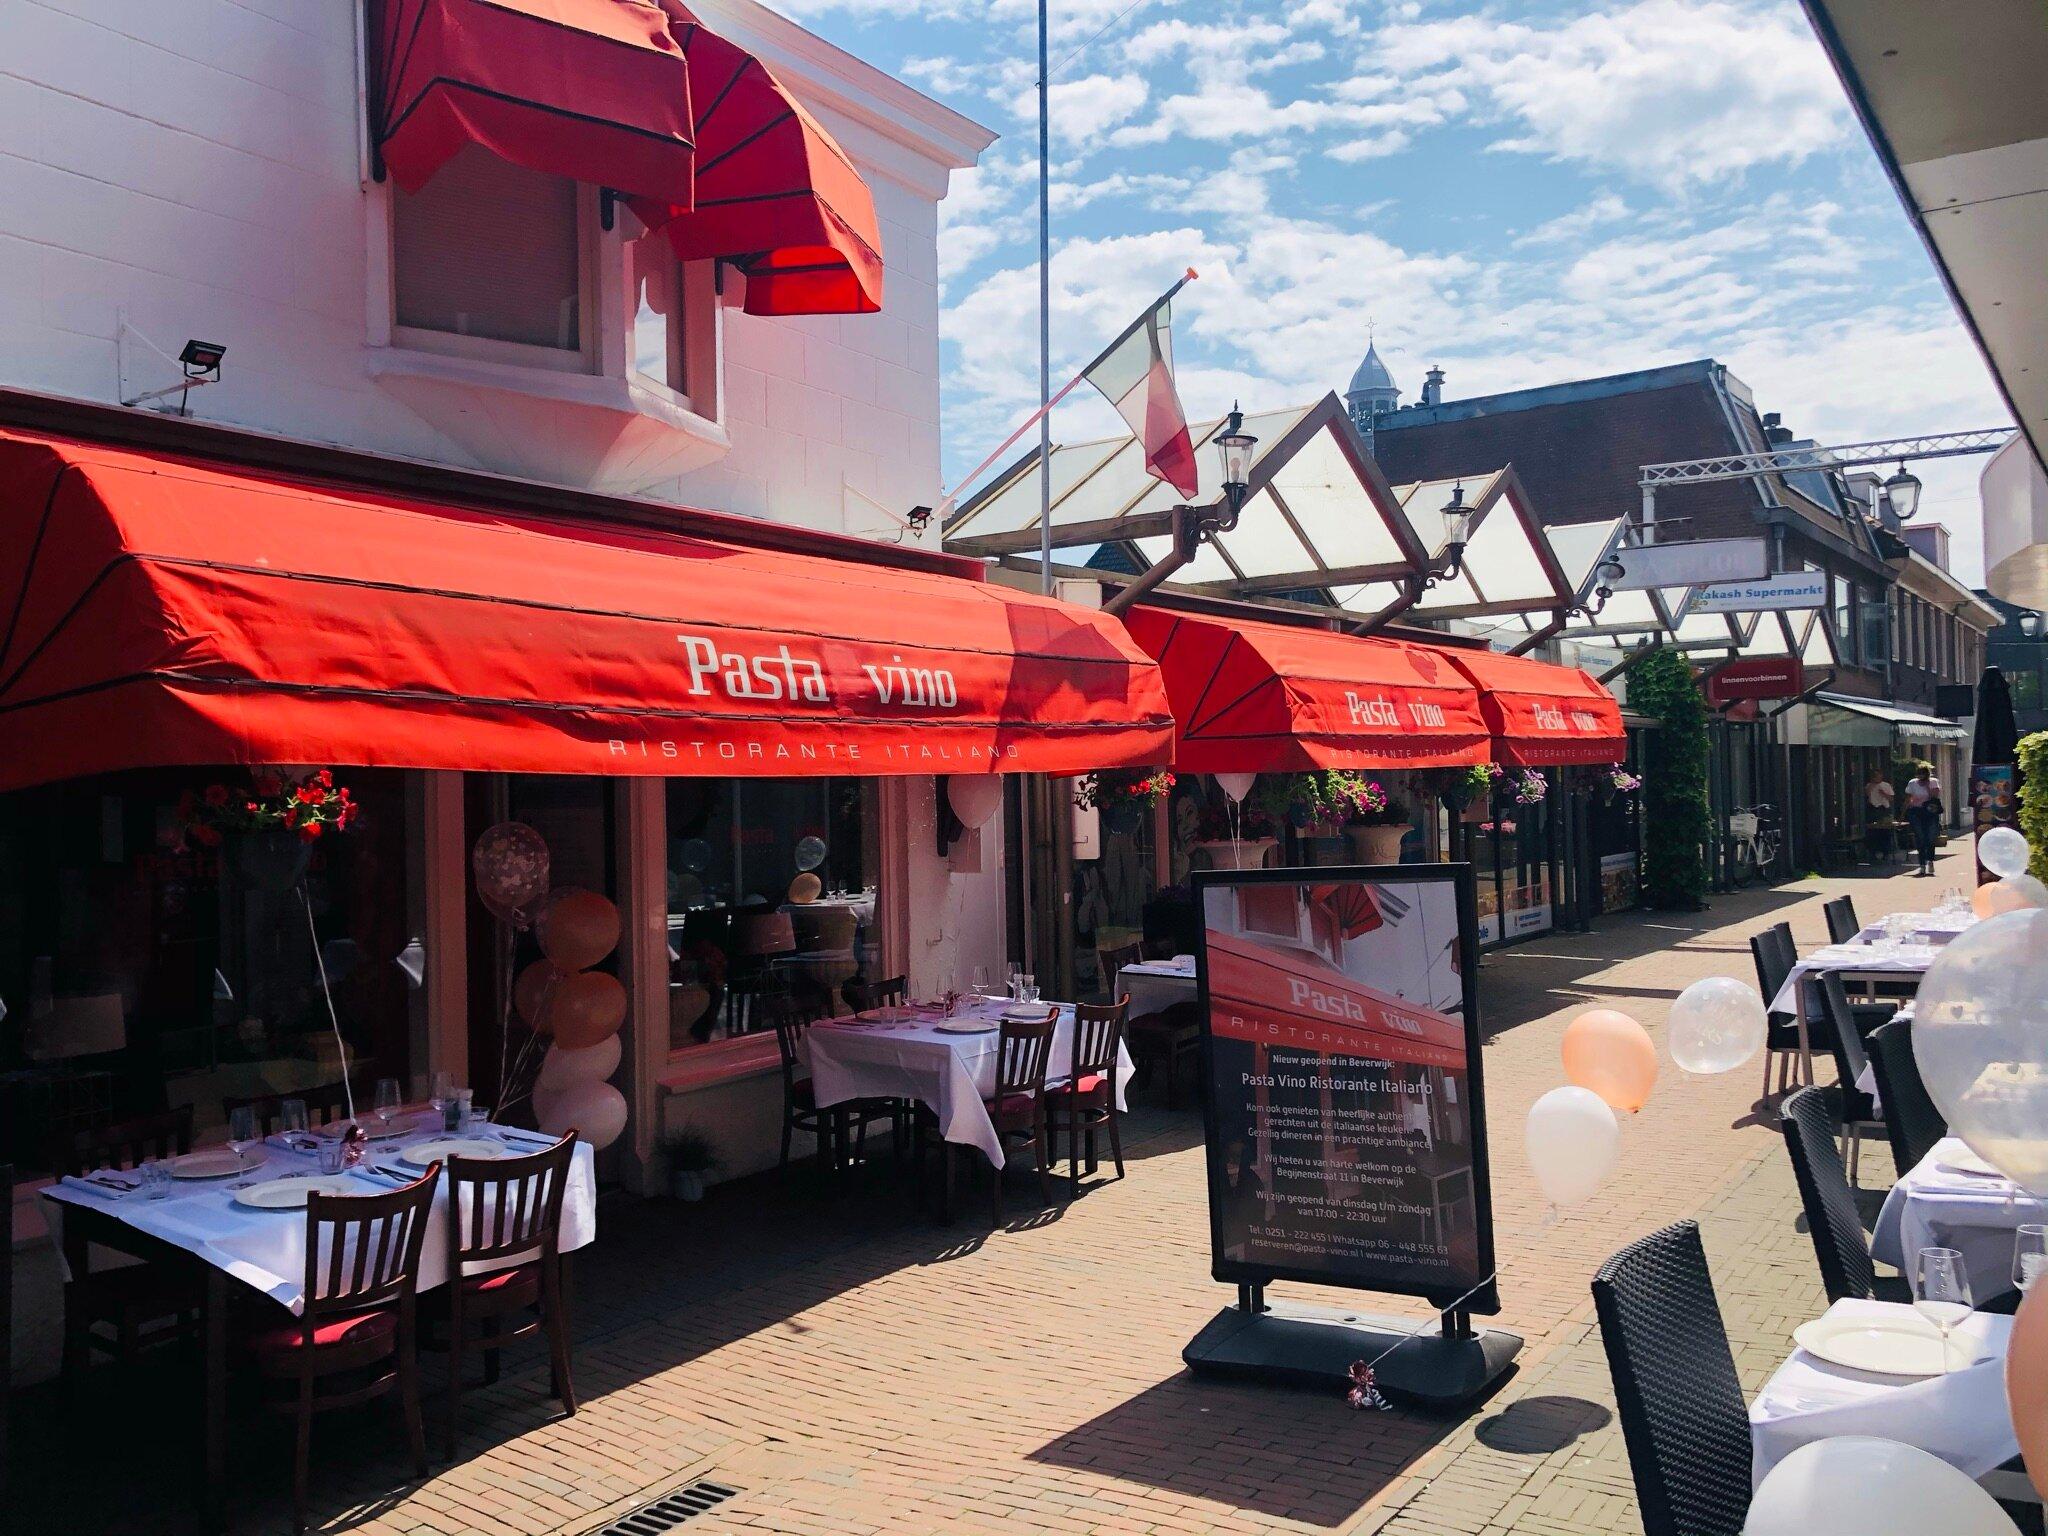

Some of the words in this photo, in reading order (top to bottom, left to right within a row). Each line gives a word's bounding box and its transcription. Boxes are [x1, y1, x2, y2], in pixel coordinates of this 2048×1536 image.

[1746, 585, 1824, 599] Supermarkt
[677, 635, 830, 702] Pasta
[861, 655, 958, 708] vino
[1344, 691, 1400, 727] Pasta
[1407, 696, 1446, 727] vino
[1532, 703, 1569, 731] Pasta
[608, 739, 861, 760] RISTORANTE
[886, 744, 1019, 759] ITALIANO
[1330, 749, 1412, 760] RISTORANTE
[1419, 748, 1475, 759] ITALIANO
[1287, 977, 1368, 1023] Pasta
[1380, 1011, 1423, 1035] vino
[1231, 1016, 1381, 1051] RISTORANTE
[1391, 1046, 1448, 1061] ITALIANO
[1272, 1054, 1299, 1064] Nieuw
[1300, 1056, 1337, 1067] geopend
[1339, 1057, 1347, 1066] in
[1349, 1057, 1395, 1070] Beverwijk:
[1242, 1072, 1275, 1087] Pasta
[1278, 1074, 1306, 1088] Vino
[1309, 1076, 1377, 1092] Ristorante
[1381, 1079, 1433, 1095] Italiano
[1246, 1102, 1264, 1112] Kom
[1265, 1104, 1281, 1113] ook
[1282, 1106, 1319, 1116] genieten
[1320, 1109, 1337, 1117] van
[1338, 1108, 1376, 1121] heerlijke
[1264, 1118, 1306, 1128] gerechten
[1307, 1119, 1319, 1129] uit
[1320, 1120, 1332, 1129] de
[1333, 1121, 1375, 1132] italiaanse
[1248, 1127, 1280, 1140] Gezellig
[1281, 1130, 1313, 1141] dineren
[1314, 1132, 1323, 1141] in
[1324, 1134, 1340, 1143] een
[1342, 1136, 1385, 1148] prachtige
[1264, 1153, 1277, 1165] Wij
[1279, 1155, 1303, 1166] heten
[1312, 1159, 1328, 1168] van
[1330, 1160, 1353, 1169] harte
[1355, 1161, 1389, 1172] welkom
[1391, 1165, 1403, 1175] op
[1405, 1165, 1417, 1174] de
[1276, 1167, 1337, 1181] Begijnenstraat
[1340, 1173, 1349, 1182] 11
[1350, 1173, 1359, 1183] in
[1361, 1174, 1404, 1188] Beverwijk
[1256, 1190, 1269, 1202] Wij
[1270, 1192, 1286, 1203] zijn
[1287, 1195, 1323, 1206] geopend
[1325, 1199, 1341, 1207] van
[1343, 1199, 1377, 1212] dinsdag
[1379, 1202, 1396, 1212] t/m
[1398, 1204, 1431, 1217] zondag
[1297, 1208, 1313, 1216] van
[1315, 1208, 1338, 1219] 17:00
[1346, 1211, 1370, 1221] 22:30
[1372, 1214, 1387, 1223] uur
[1265, 1227, 1286, 1238] 0251
[1294, 1230, 1309, 1240] 222
[1311, 1232, 1326, 1242] 455
[1332, 1234, 1376, 1249] Whatsapp
[1399, 1241, 1417, 1253] 448
[1418, 1243, 1435, 1254] 555
[1365, 1251, 1449, 1267] www.pasta-vino.nl
